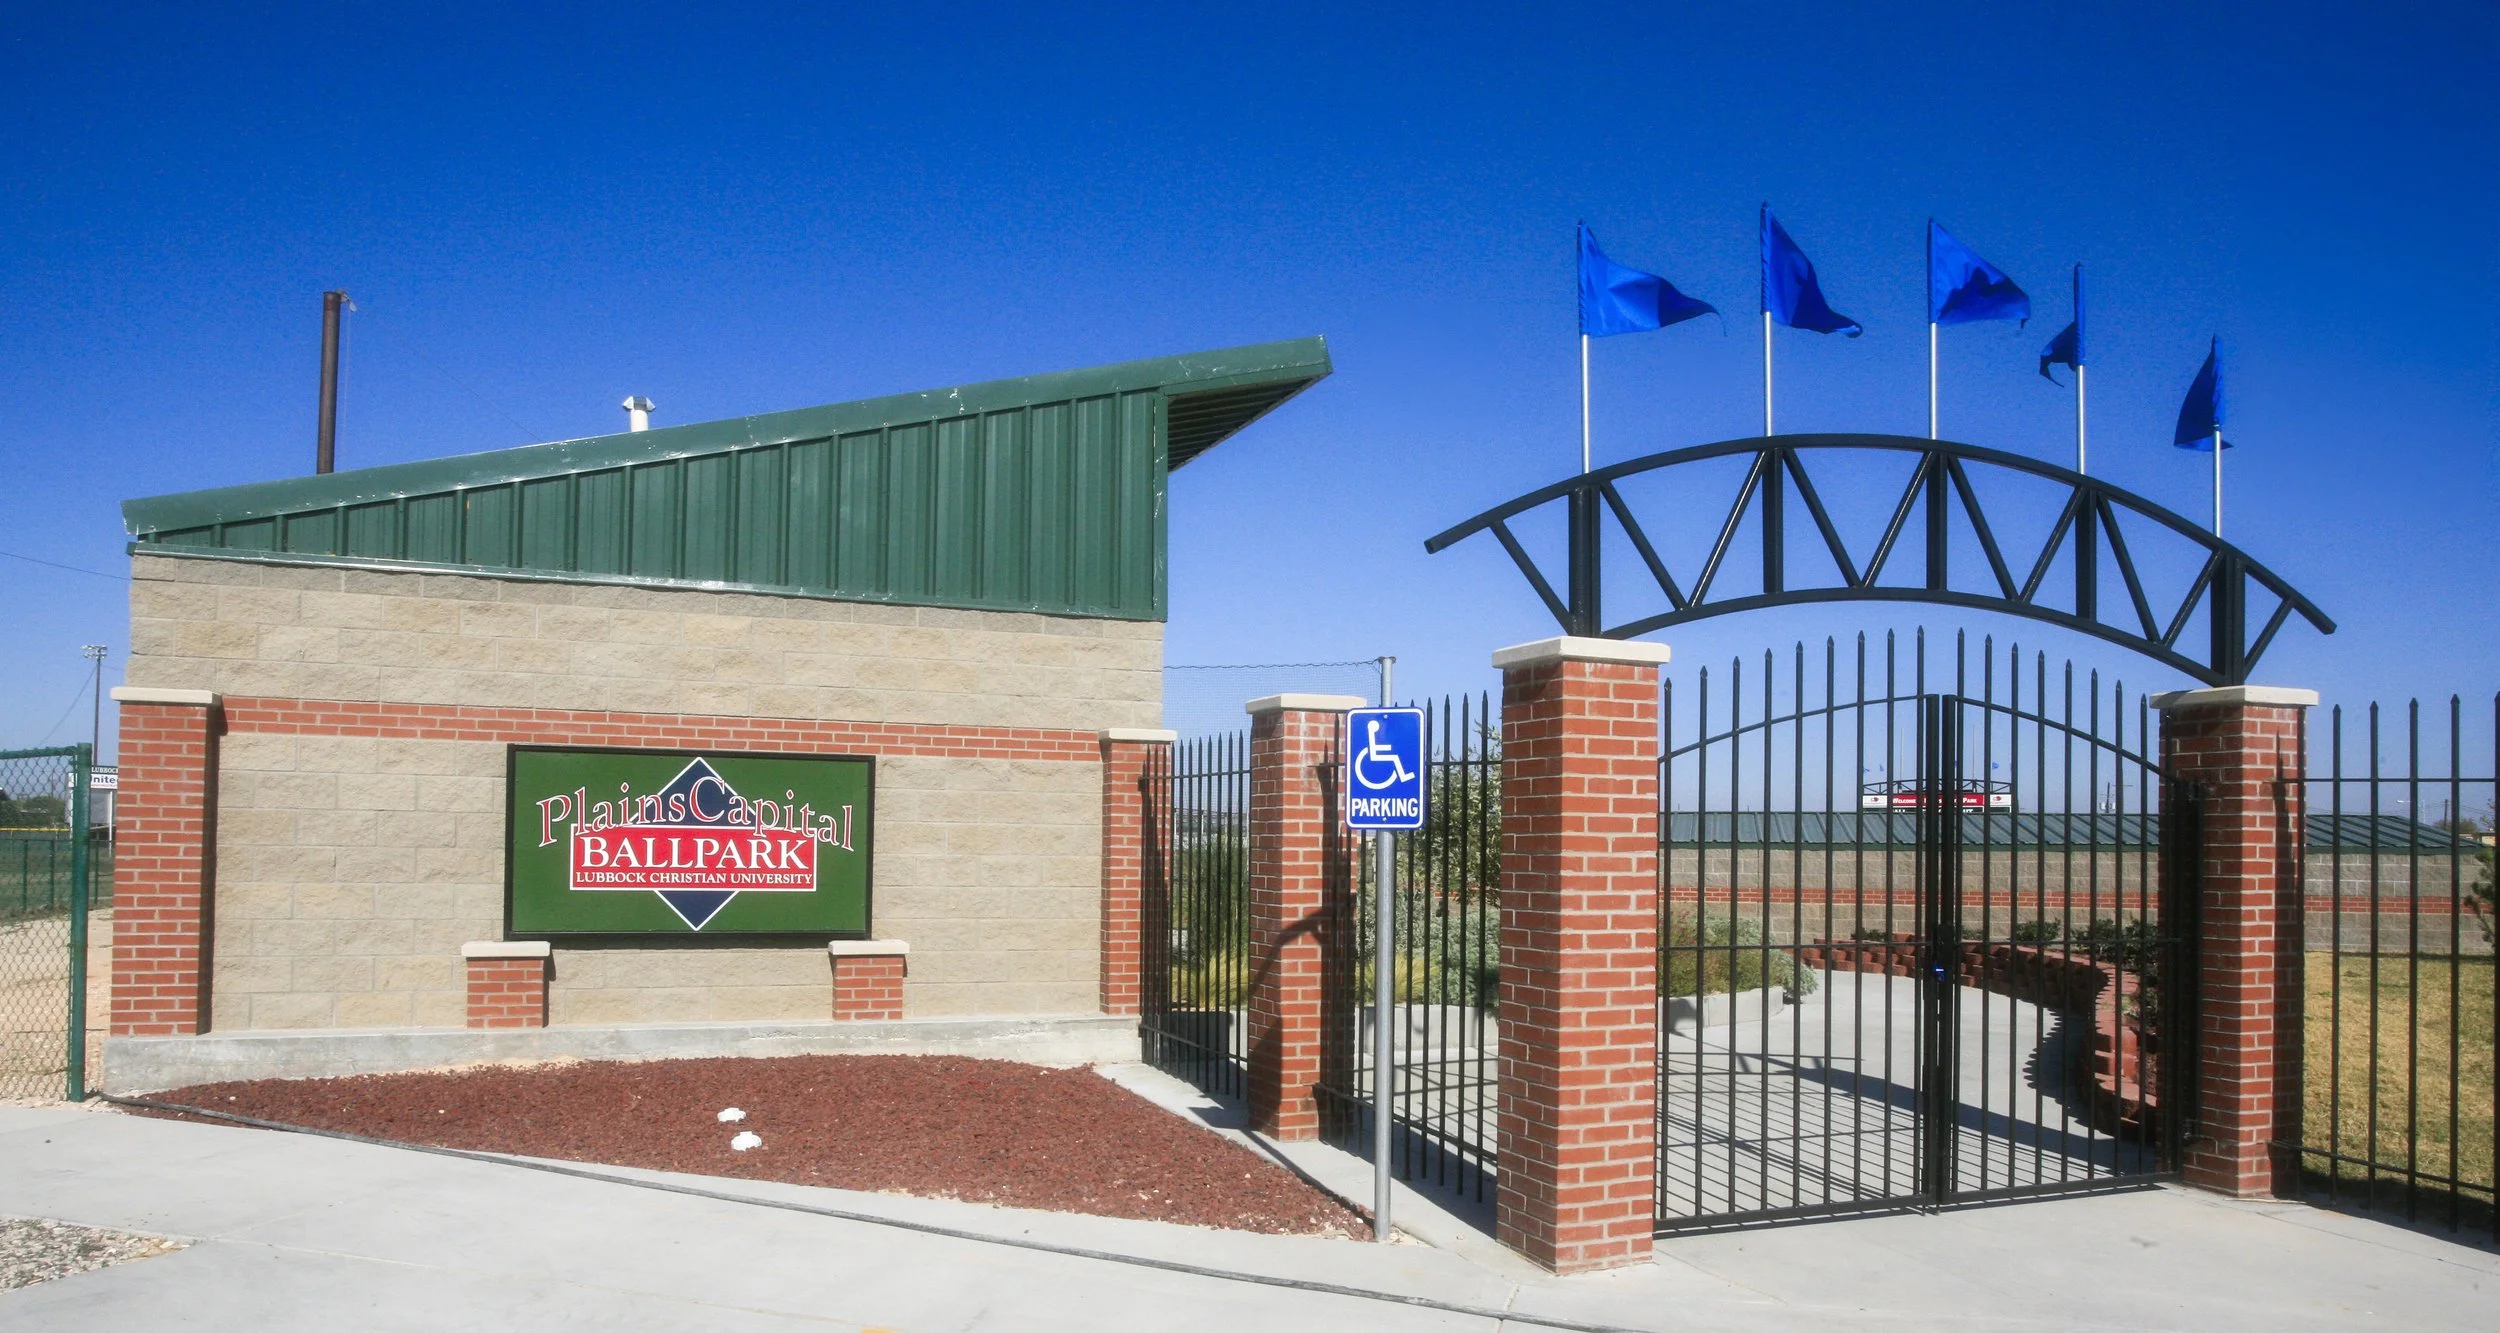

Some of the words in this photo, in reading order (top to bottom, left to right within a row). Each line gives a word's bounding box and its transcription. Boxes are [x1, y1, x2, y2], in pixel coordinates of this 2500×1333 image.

[536, 776, 854, 852] PlainsCapital
[1351, 798, 1418, 817] PARKING
[580, 836, 809, 869] BALLPARK
[575, 871, 646, 883] LUBBOCK
[649, 872, 726, 884] CHRISTIAN
[730, 873, 812, 884] UNIVERSITY
